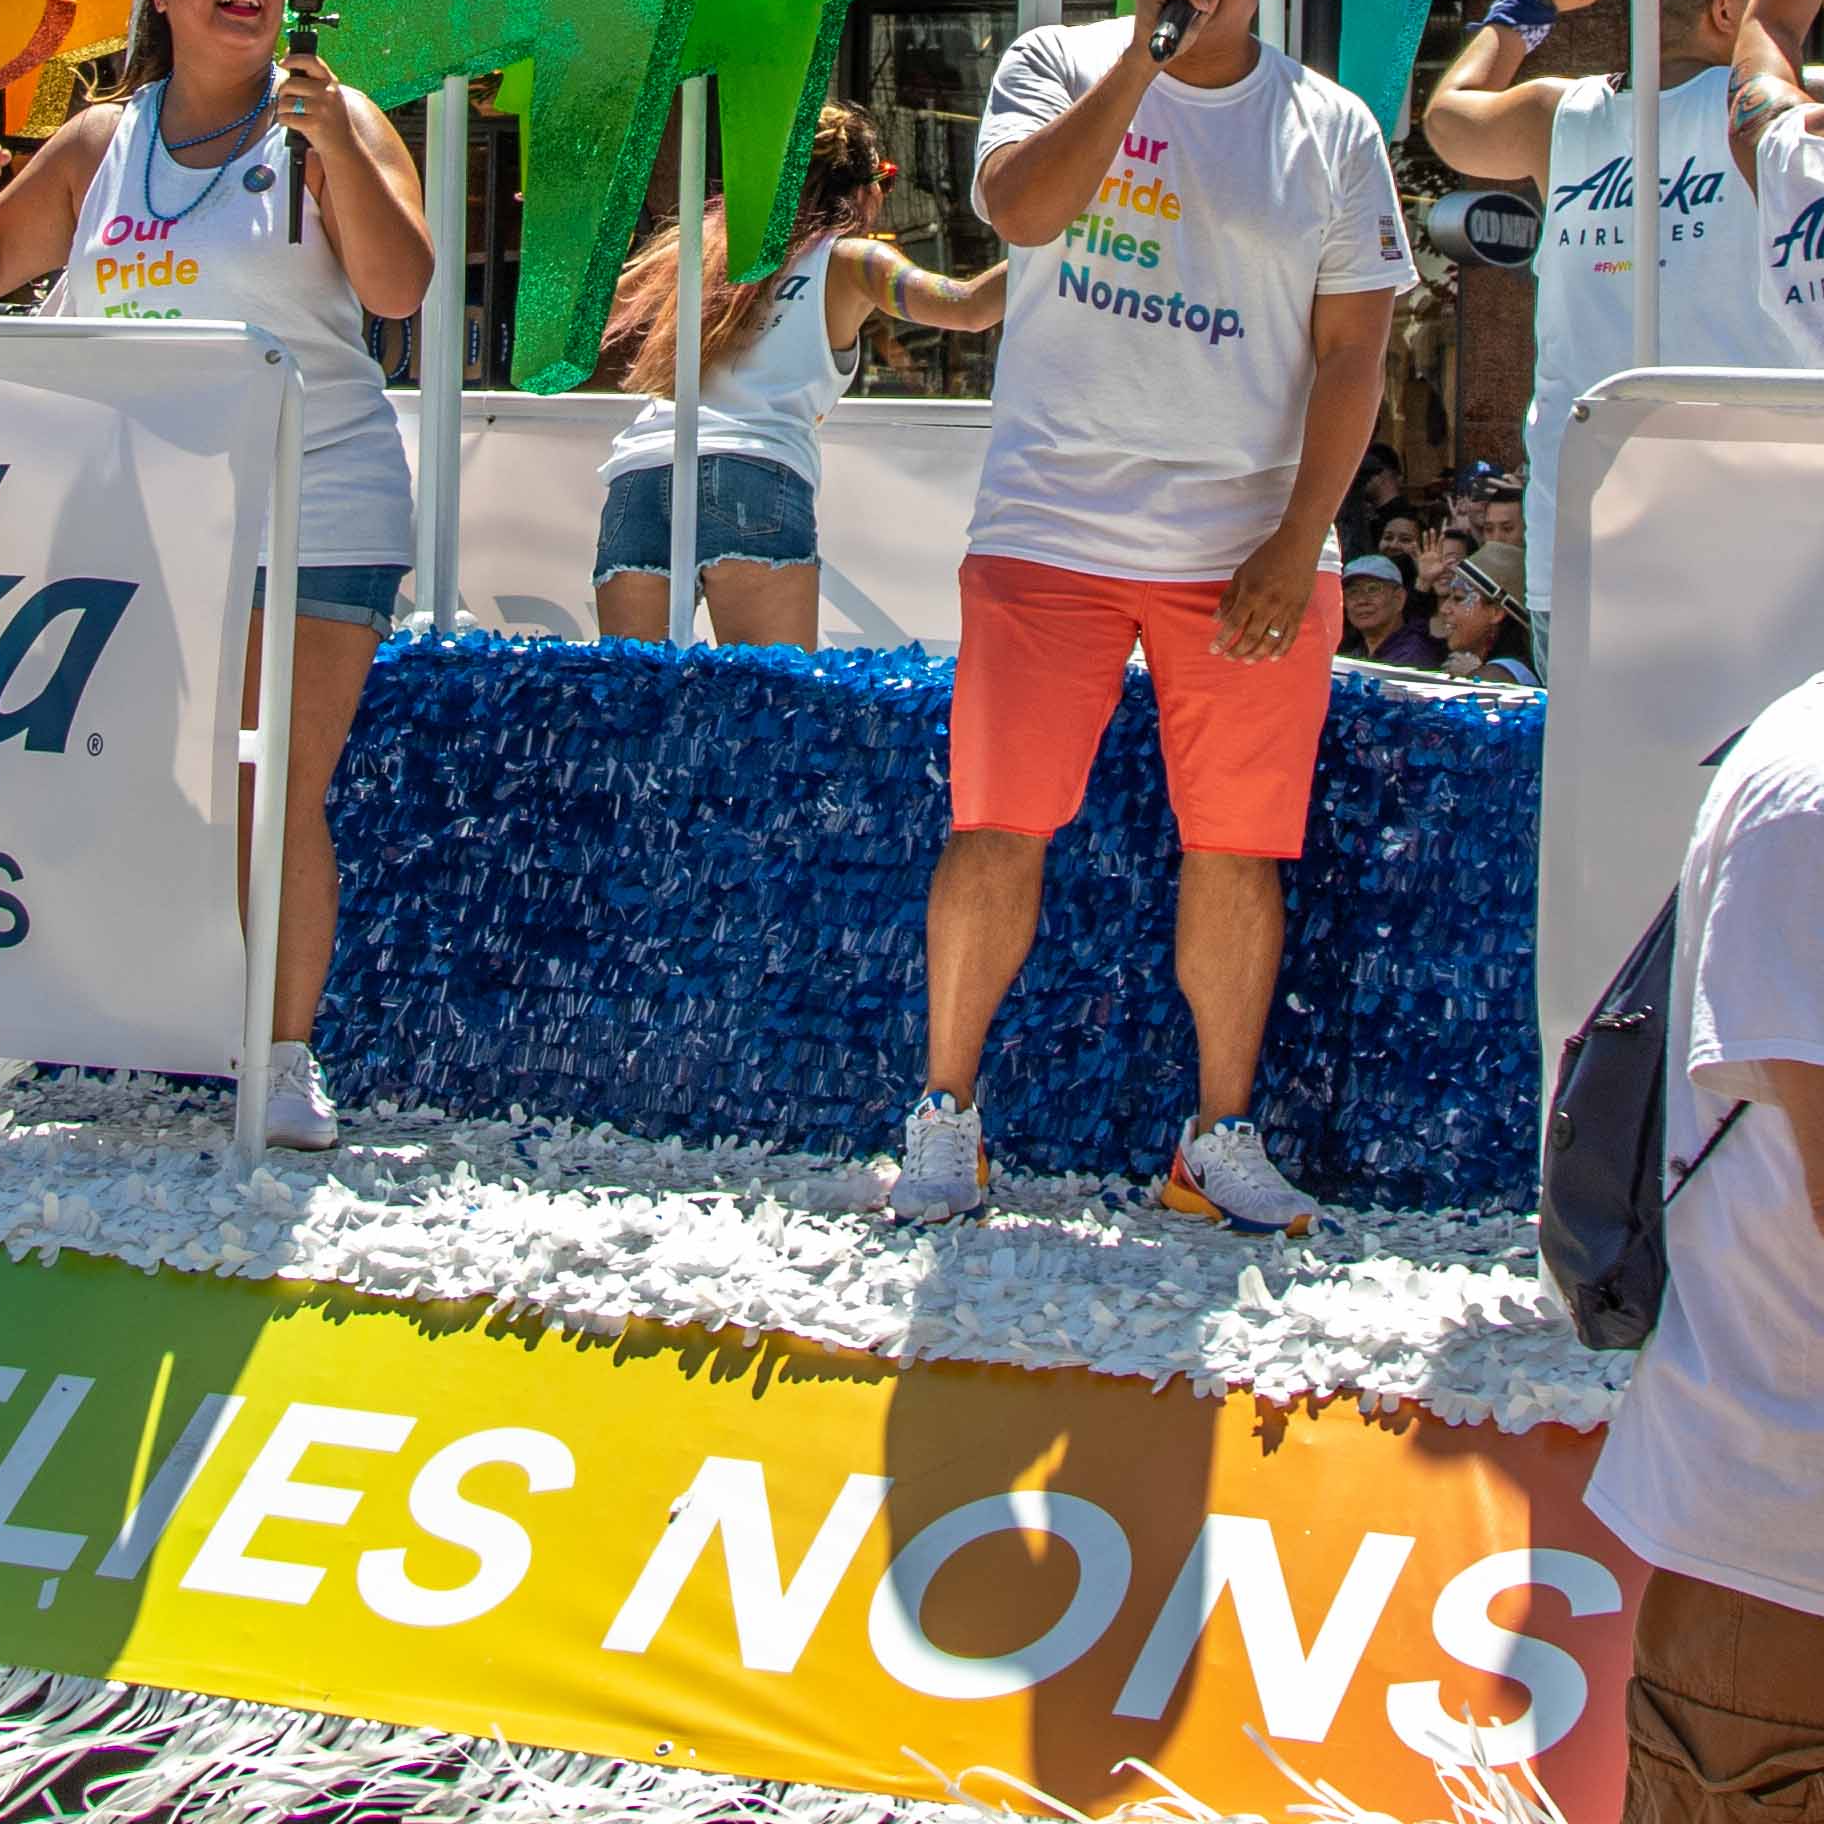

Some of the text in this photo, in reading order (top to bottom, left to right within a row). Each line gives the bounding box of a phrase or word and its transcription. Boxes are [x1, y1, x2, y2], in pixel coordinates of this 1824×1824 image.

[1123, 132, 1169, 165] ur
[1098, 169, 1182, 222] ride
[101, 214, 179, 246] Our
[1065, 212, 1161, 270] Flies
[1471, 208, 1500, 244] OLD
[1559, 221, 1705, 247] AIRLES
[95, 250, 200, 296] Pride
[1057, 260, 1246, 346] Nonstop.
